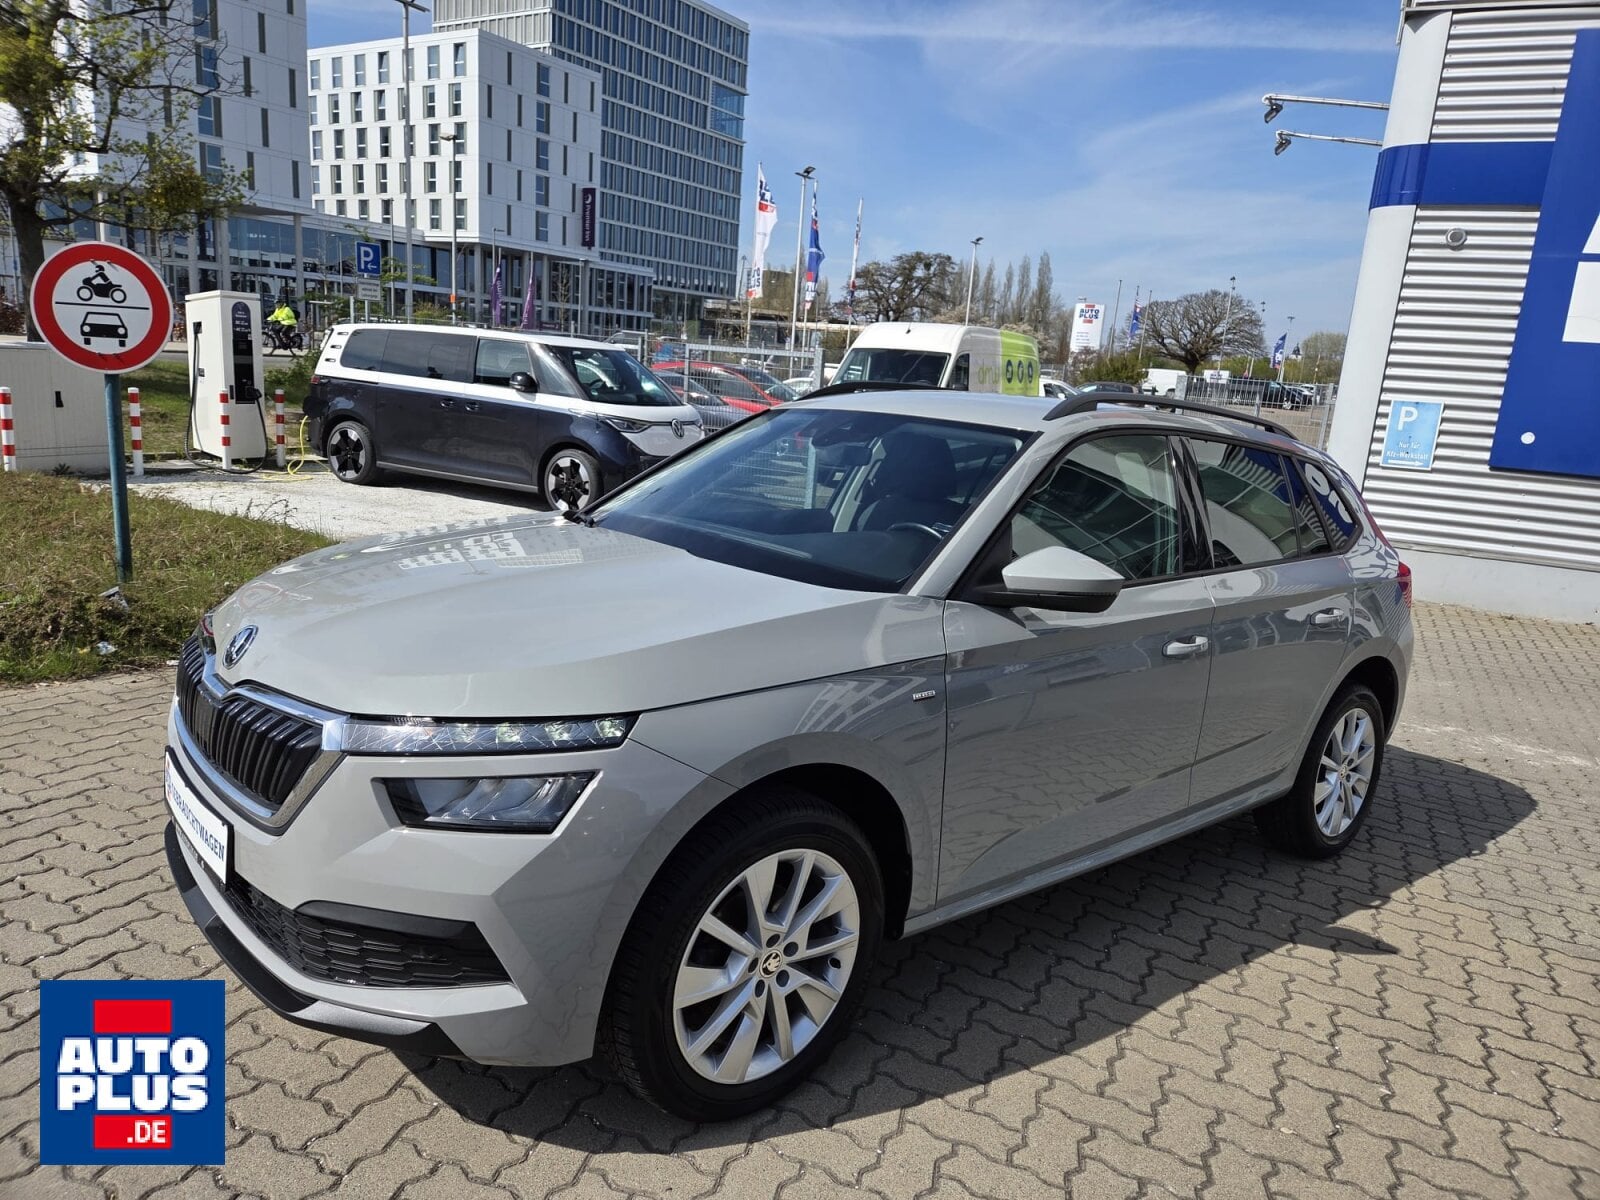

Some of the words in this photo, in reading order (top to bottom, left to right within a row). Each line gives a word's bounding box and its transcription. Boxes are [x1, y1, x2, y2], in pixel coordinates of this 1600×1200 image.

[360, 246, 374, 270] P
[1397, 406, 1419, 431] P
[1411, 441, 1420, 449] für
[1386, 451, 1429, 460] Kfz-Werkstatt
